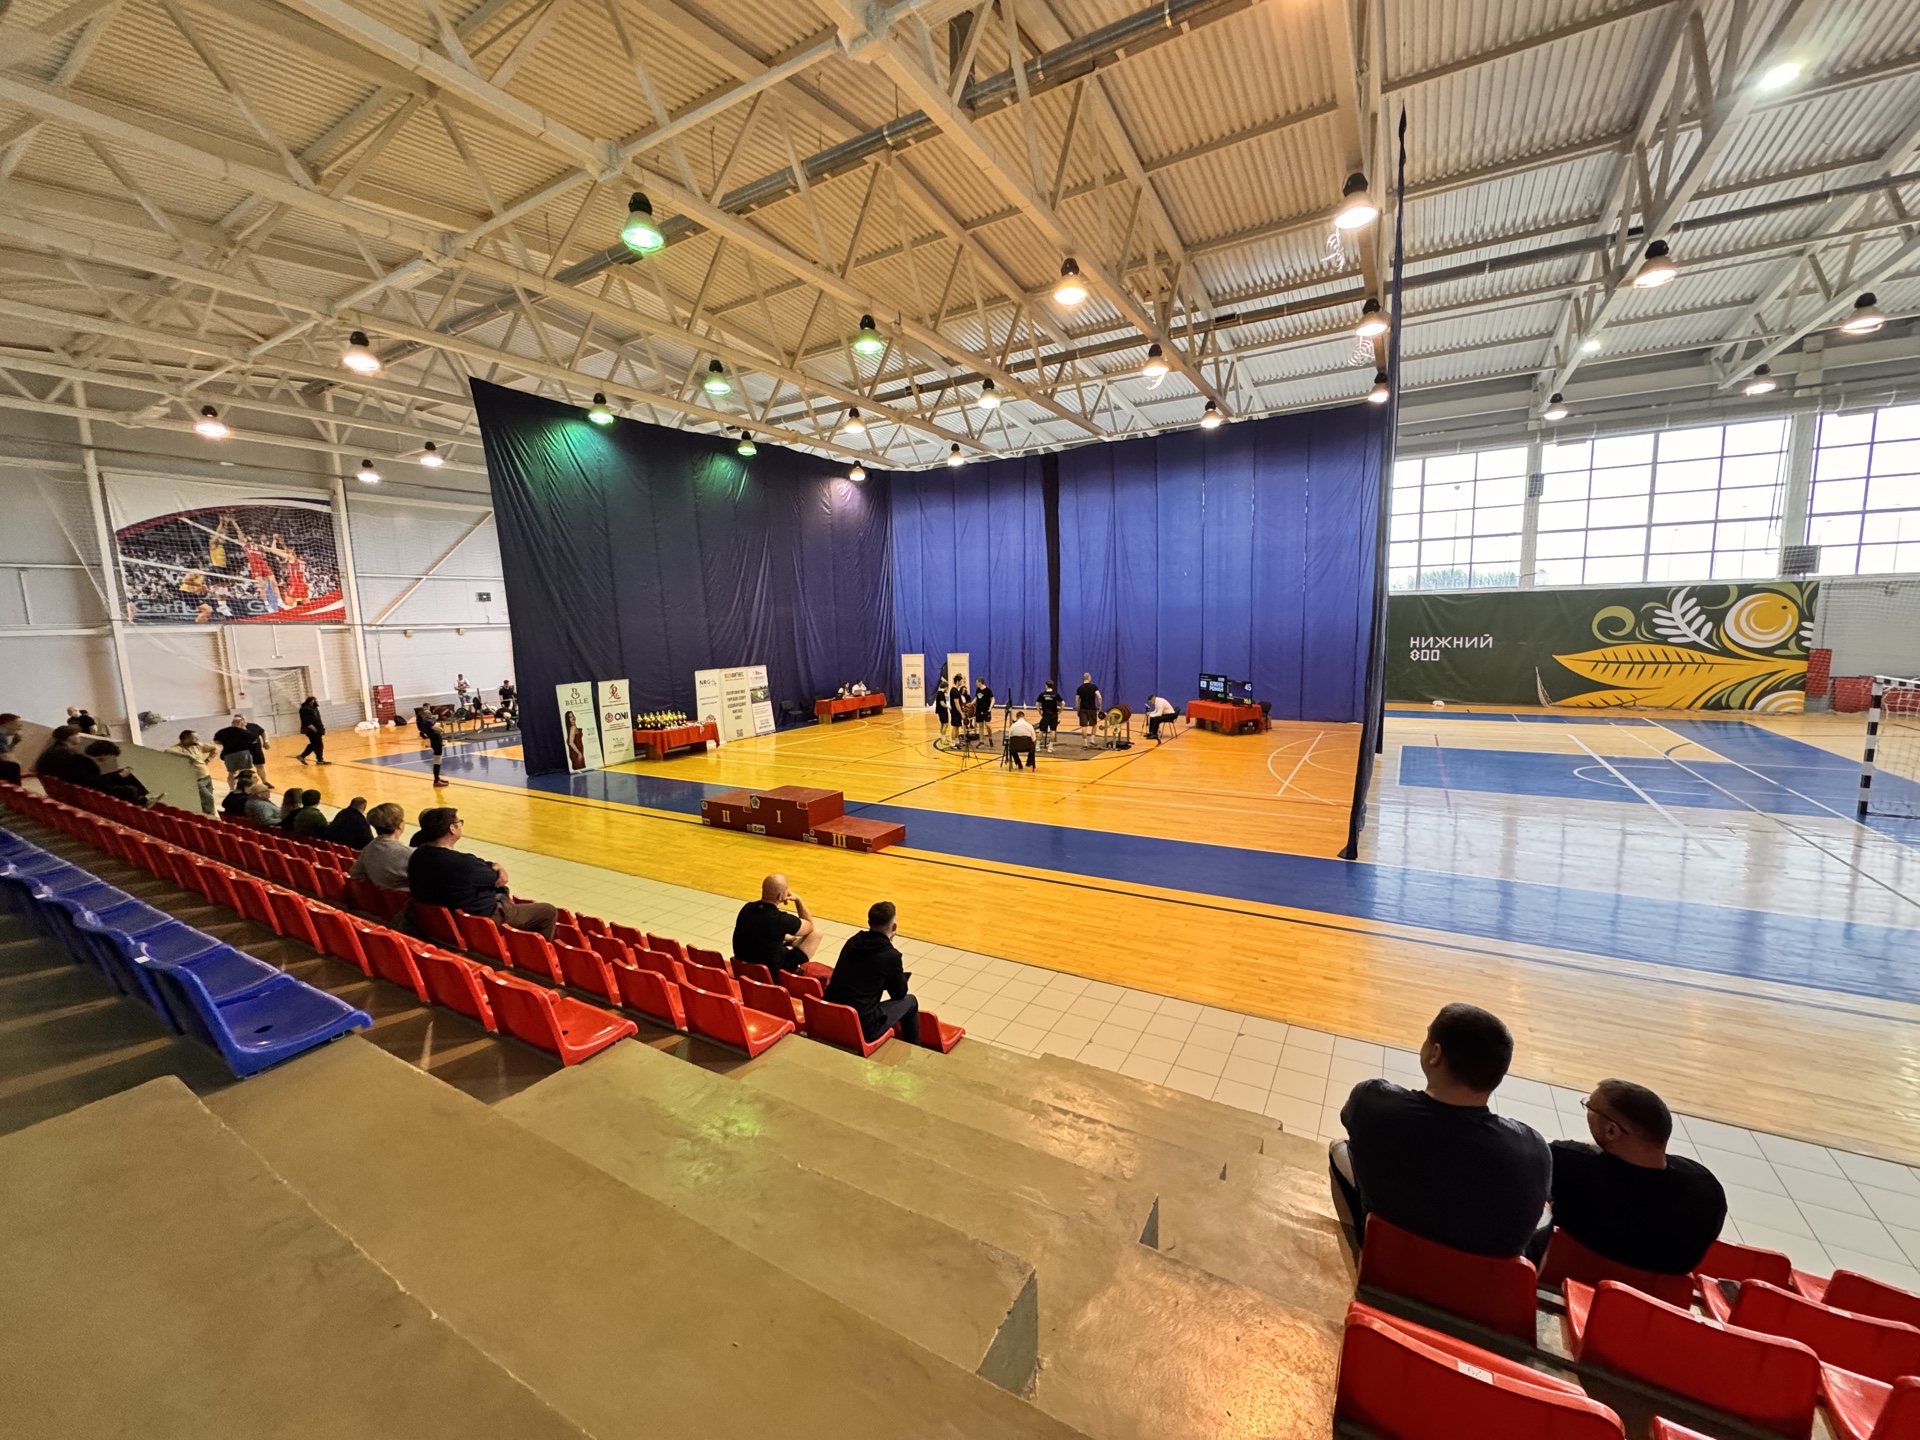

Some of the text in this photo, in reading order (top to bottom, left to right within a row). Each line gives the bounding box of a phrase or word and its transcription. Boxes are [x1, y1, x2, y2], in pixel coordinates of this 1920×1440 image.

[134, 599, 200, 614] Gerflo
[1410, 633, 1493, 648] НИЖНИЙ
[1410, 649, 1440, 661] 800
[614, 712, 628, 720] ONI
[722, 809, 731, 823] II
[776, 810, 783, 824] I
[832, 833, 848, 848] III
